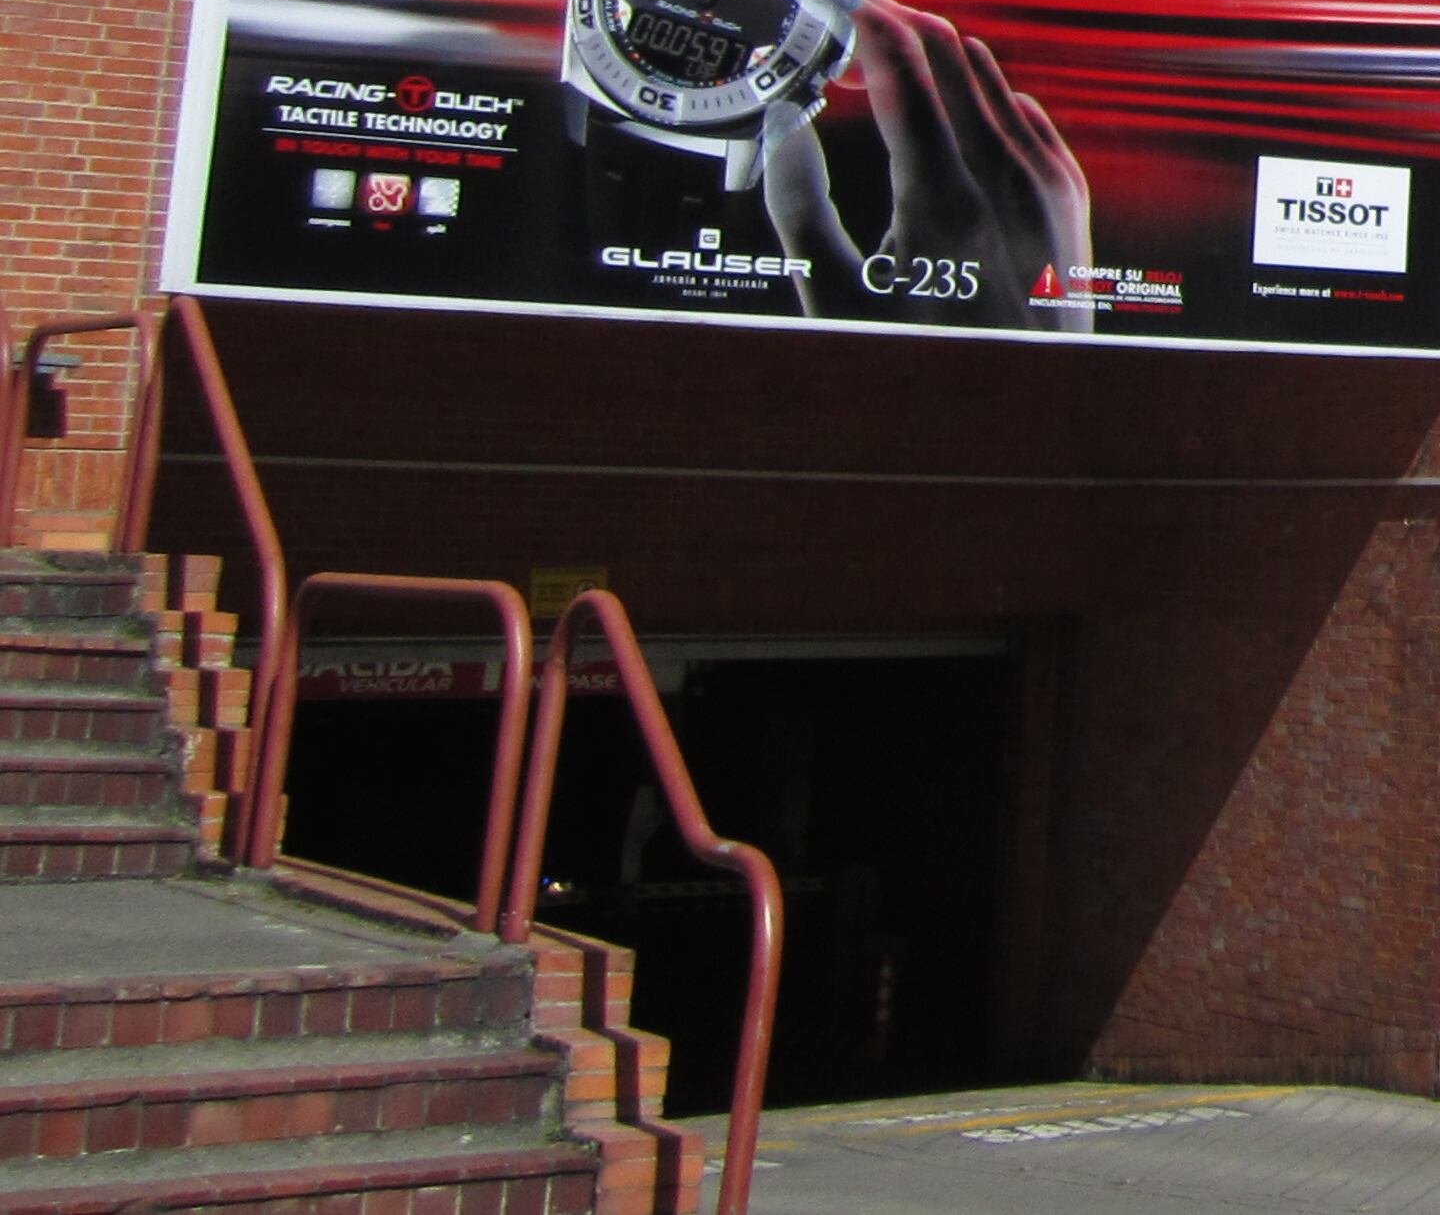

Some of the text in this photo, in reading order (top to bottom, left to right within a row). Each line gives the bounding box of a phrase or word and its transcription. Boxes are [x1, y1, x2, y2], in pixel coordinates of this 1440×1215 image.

[278, 105, 509, 141] TACTILE TECHNOLOGY
[1276, 198, 1390, 228] TISSOT
[600, 245, 814, 279] GLAUSER
[1068, 265, 1122, 281] COMPRE
[1125, 268, 1143, 282] SU
[860, 253, 982, 300] C-235
[1115, 281, 1182, 298] ORIGINAL
[1252, 282, 1297, 297] Experience
[339, 676, 453, 693] VEHICULAR
